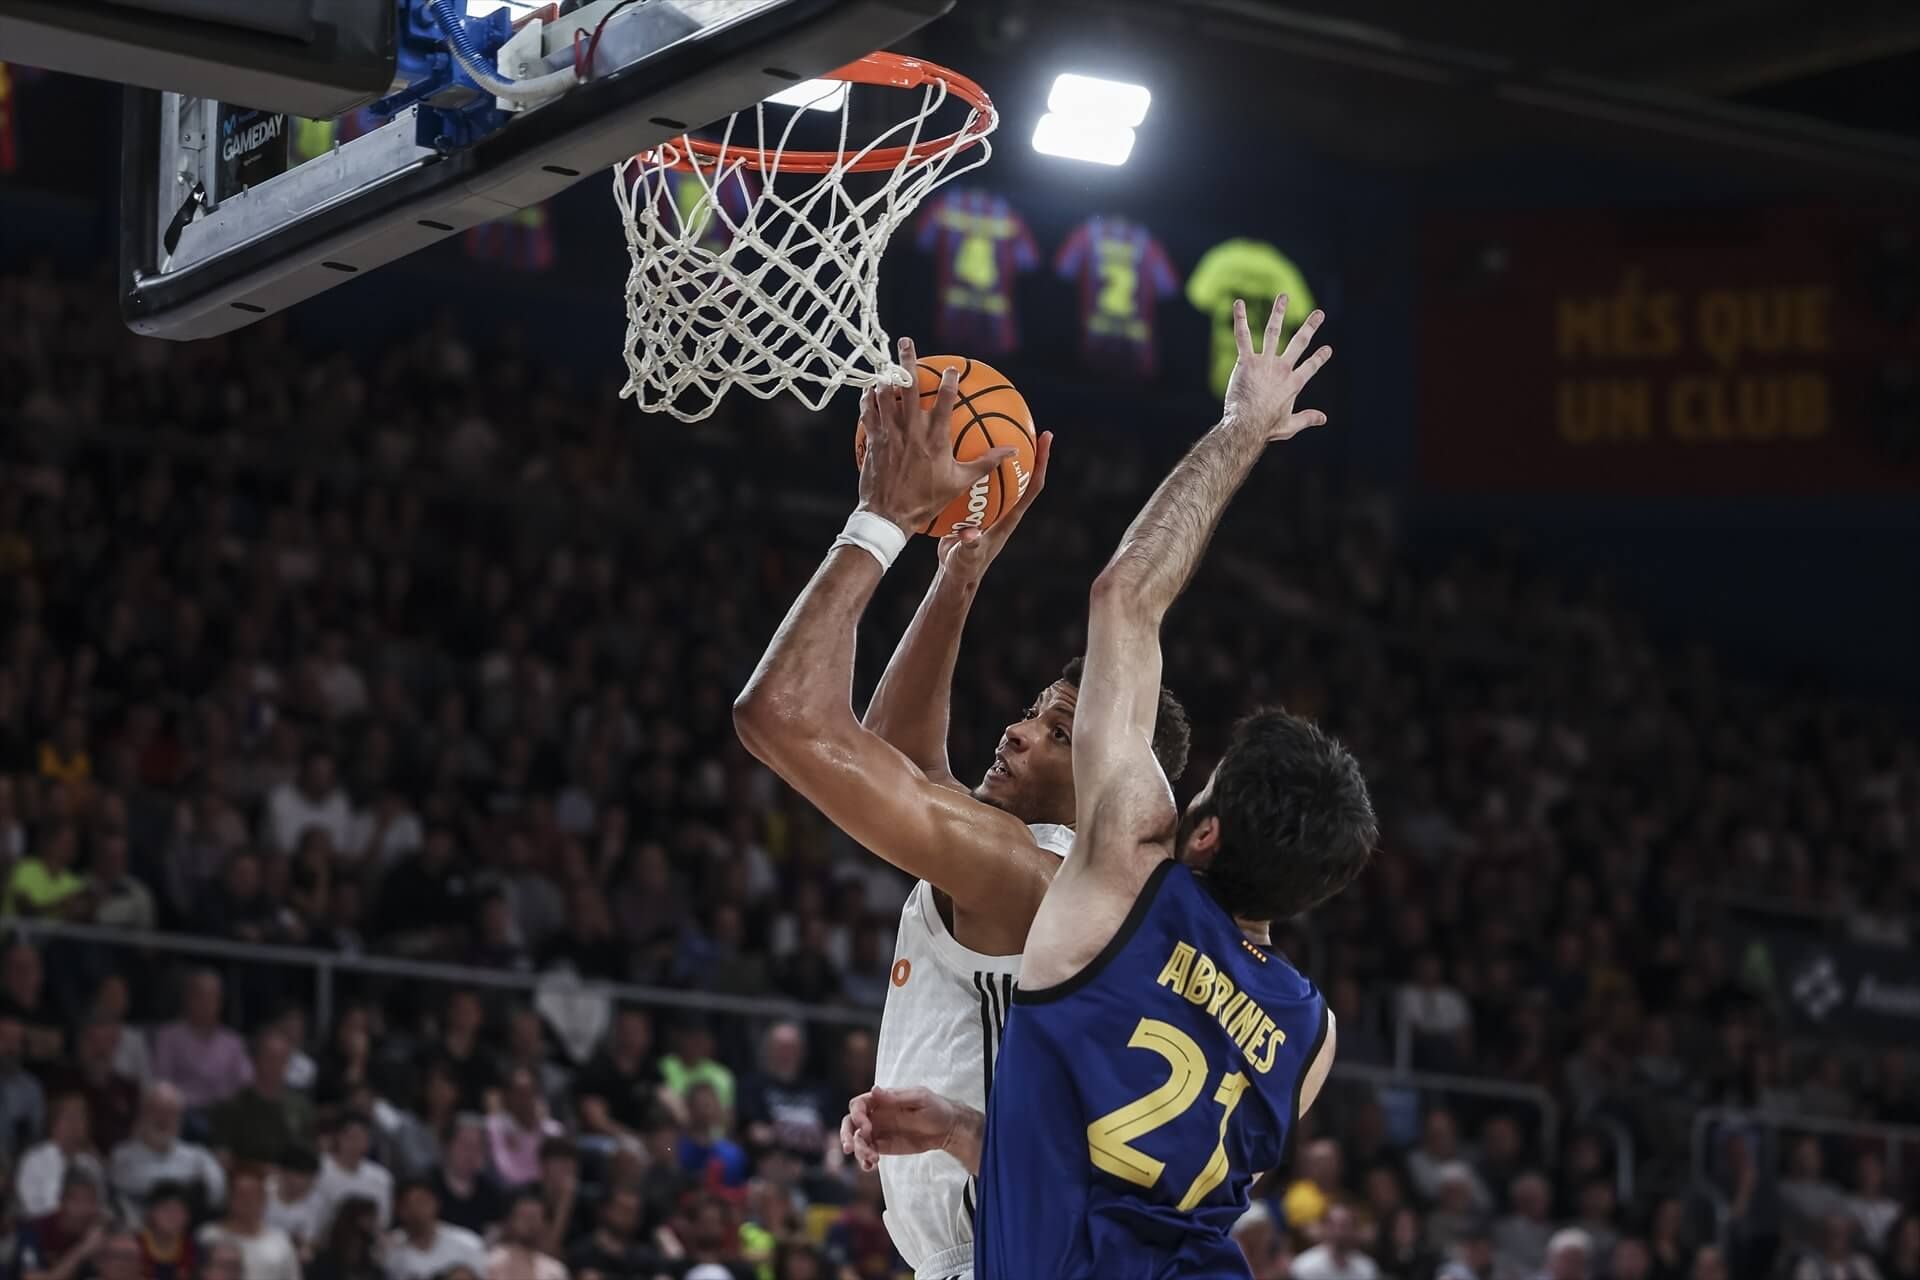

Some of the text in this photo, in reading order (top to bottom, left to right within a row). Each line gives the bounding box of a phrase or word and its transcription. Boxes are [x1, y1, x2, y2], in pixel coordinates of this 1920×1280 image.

[223, 113, 283, 161] GAMEDAY
[1557, 268, 1832, 367] MÉS QUE
[1557, 371, 1831, 446] UN CLUB
[952, 474, 989, 535] lson
[1156, 940, 1287, 1074] ABRINES
[1087, 1016, 1251, 1213] 21
